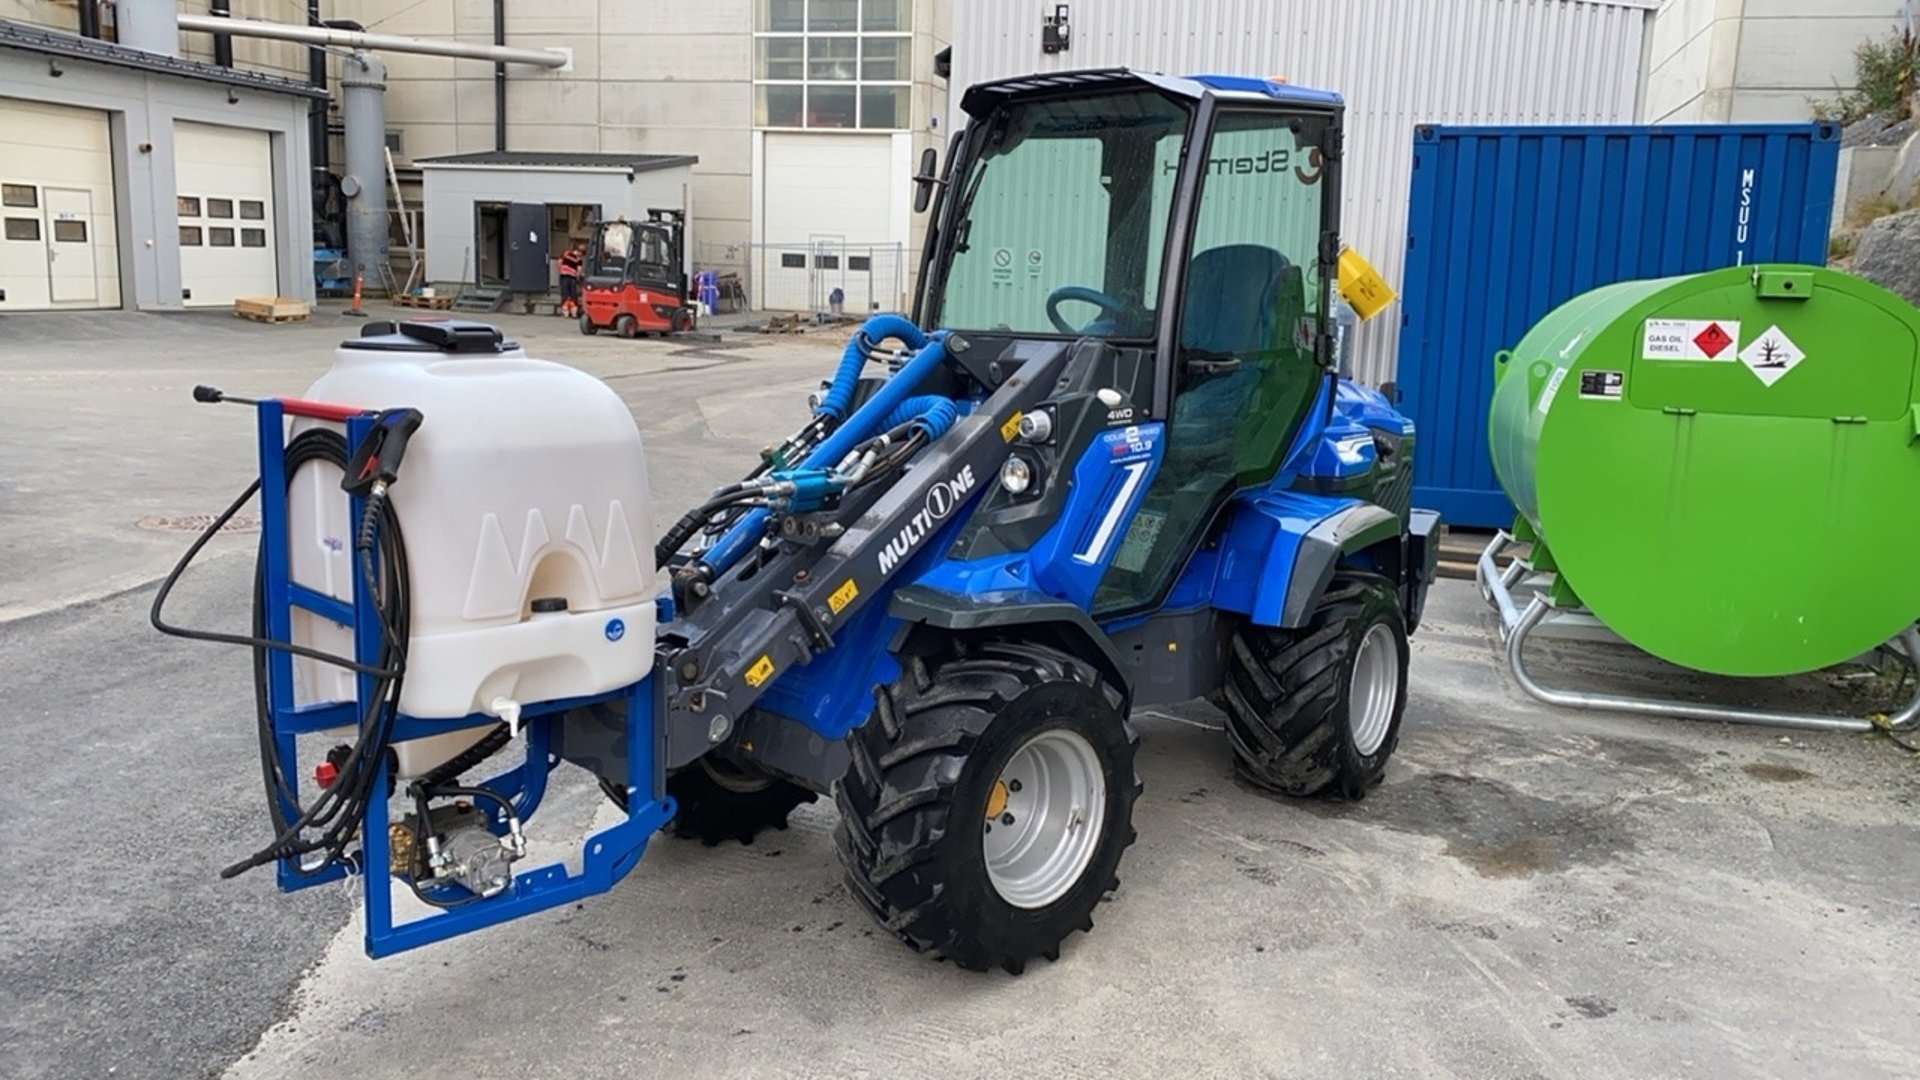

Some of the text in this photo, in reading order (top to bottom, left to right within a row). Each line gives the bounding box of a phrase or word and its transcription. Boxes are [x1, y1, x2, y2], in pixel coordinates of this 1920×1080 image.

[1737, 169, 1754, 243] MSUU
[1648, 335, 1667, 343] GAS
[1649, 344, 1680, 352] DIESEL
[1107, 408, 1133, 420] 4WD
[1129, 440, 1152, 452] 10.9
